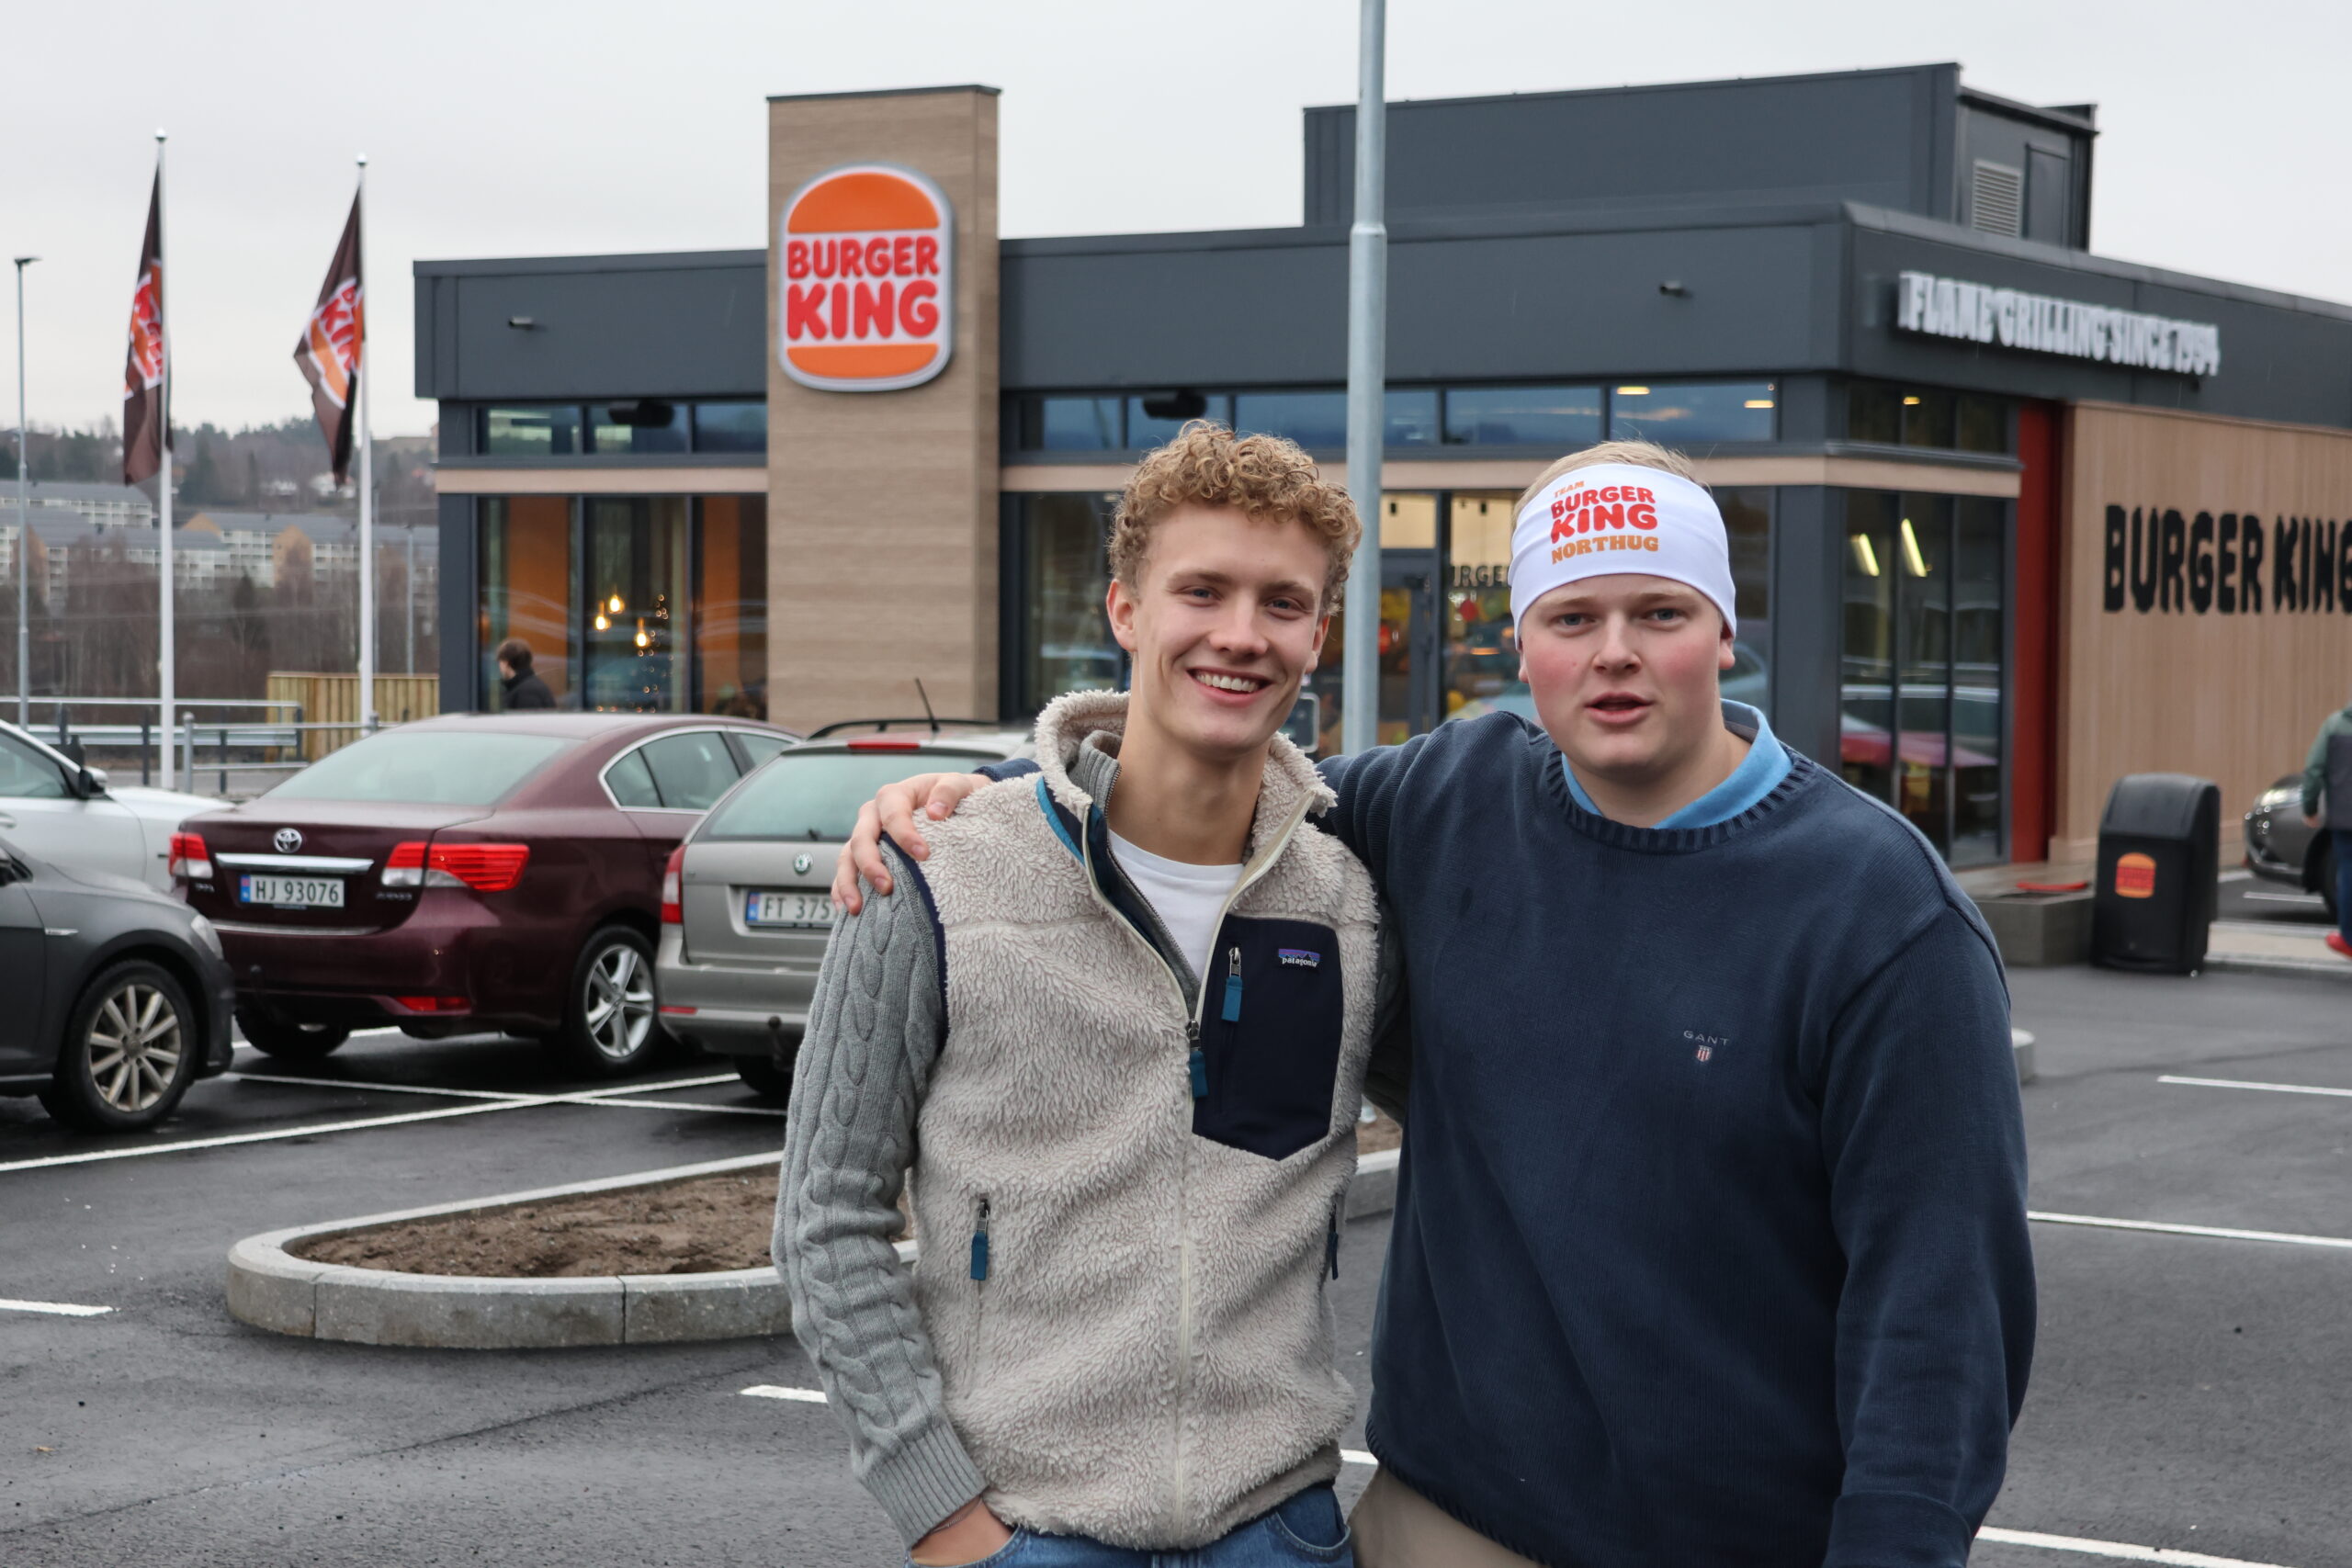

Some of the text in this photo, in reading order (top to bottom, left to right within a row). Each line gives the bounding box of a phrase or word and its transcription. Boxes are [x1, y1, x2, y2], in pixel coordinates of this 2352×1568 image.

[787, 236, 938, 279] BURGER
[787, 279, 939, 340] KING
[1898, 271, 1995, 344] FLAME
[1996, 288, 2107, 361] GRILLING
[2108, 309, 2170, 370] SINCE
[1551, 486, 1656, 519] BURGER
[1554, 480, 1585, 498] TEAM
[1551, 503, 1657, 544] KING
[1552, 536, 1659, 565] NORTHUG
[2104, 503, 2263, 615] BURGER
[255, 880, 339, 904] HJ 93076
[764, 897, 837, 919] FT 375
[1282, 957, 1317, 967] patagonia
[1683, 1030, 1729, 1046] GANT
